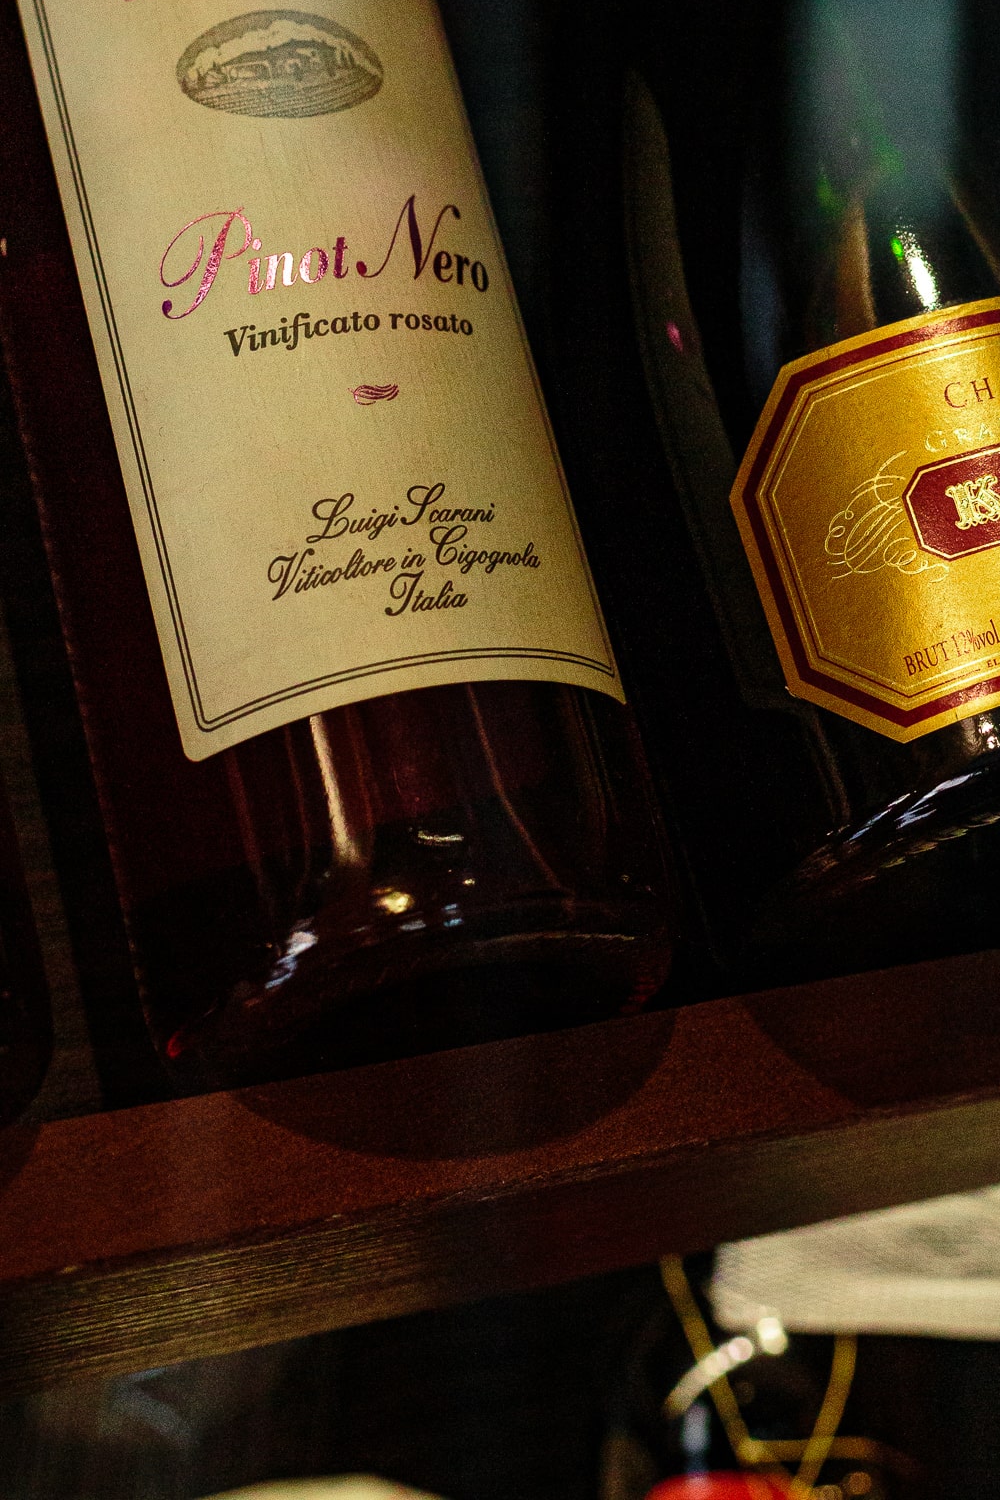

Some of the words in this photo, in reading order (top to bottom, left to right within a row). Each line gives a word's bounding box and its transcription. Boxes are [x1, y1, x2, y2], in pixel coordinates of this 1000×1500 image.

[160, 206, 348, 320] Pinot
[356, 194, 489, 293] Nero
[223, 312, 380, 357] Vinificato
[388, 312, 474, 336] rosato
[306, 492, 400, 544] Luigi
[400, 482, 496, 526] Scarani
[267, 547, 397, 601] Viticoltore
[400, 547, 426, 570] in
[429, 524, 541, 574] Cigognola
[384, 569, 469, 617] Italia
[903, 640, 950, 677] BRUT
